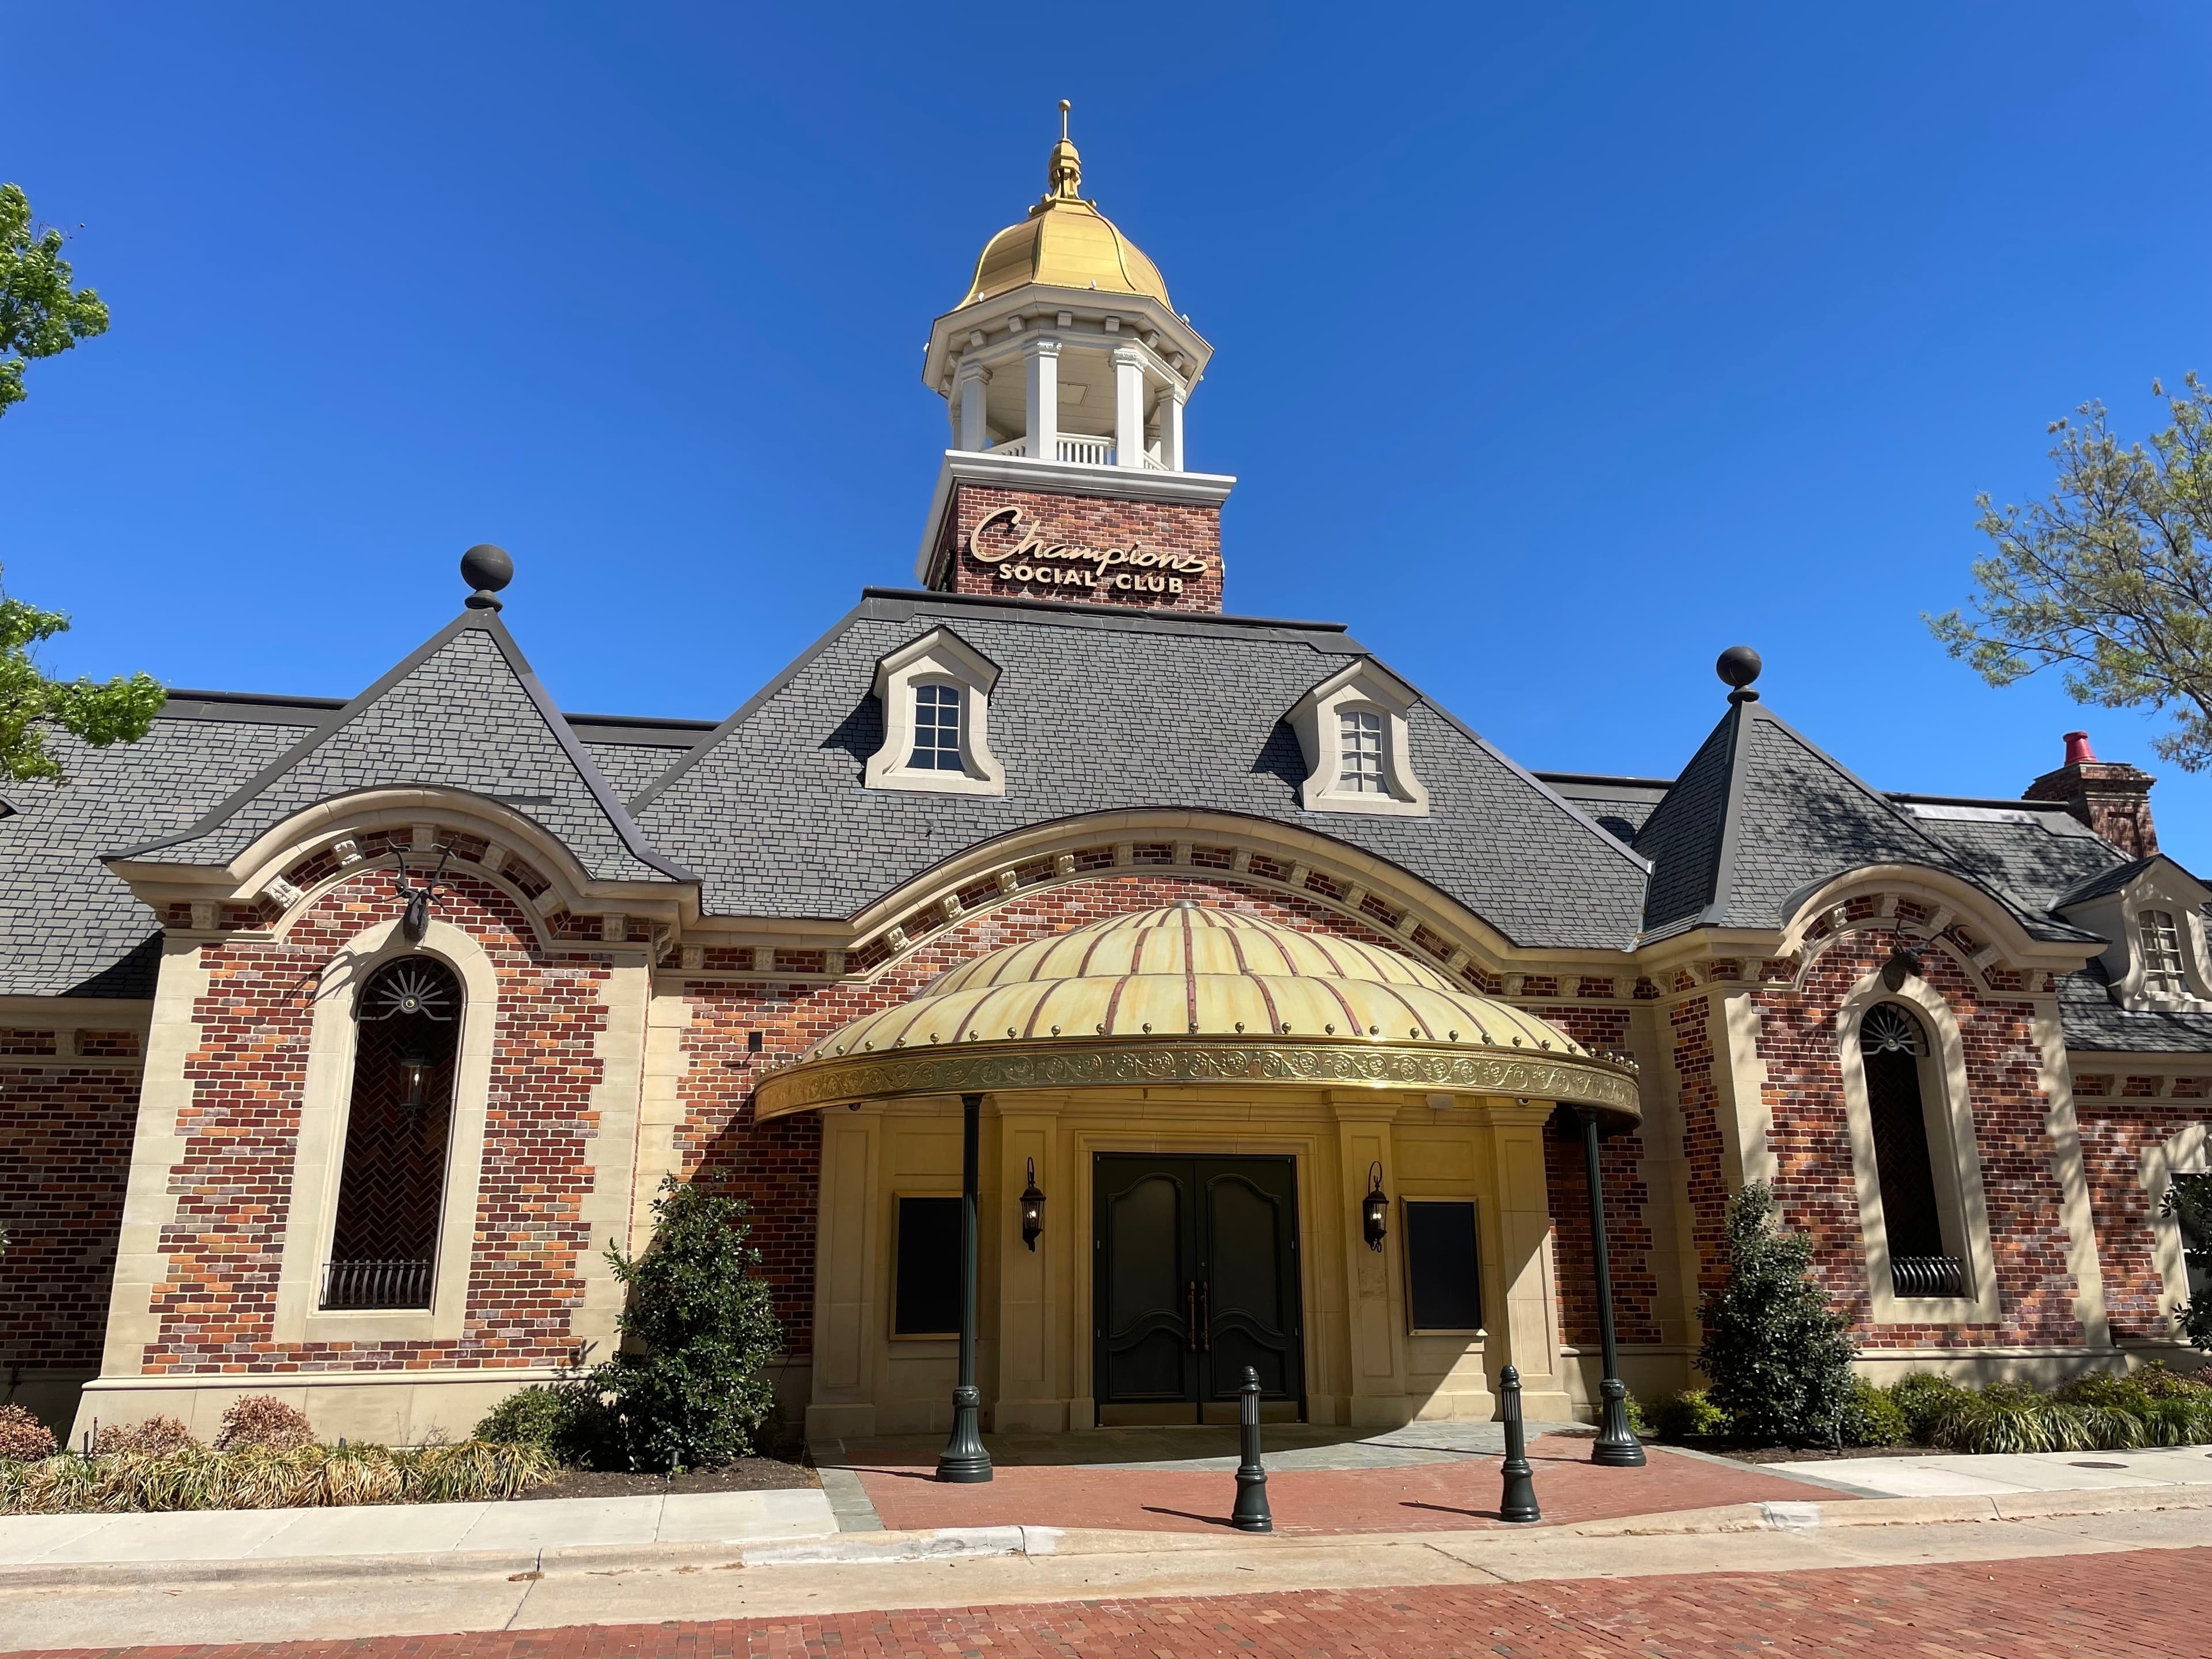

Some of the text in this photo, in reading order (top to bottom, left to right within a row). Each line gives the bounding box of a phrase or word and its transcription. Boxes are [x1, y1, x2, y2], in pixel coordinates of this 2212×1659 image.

[970, 506, 1208, 576] Champions
[999, 563, 1183, 593] SOCIAL CLUB
